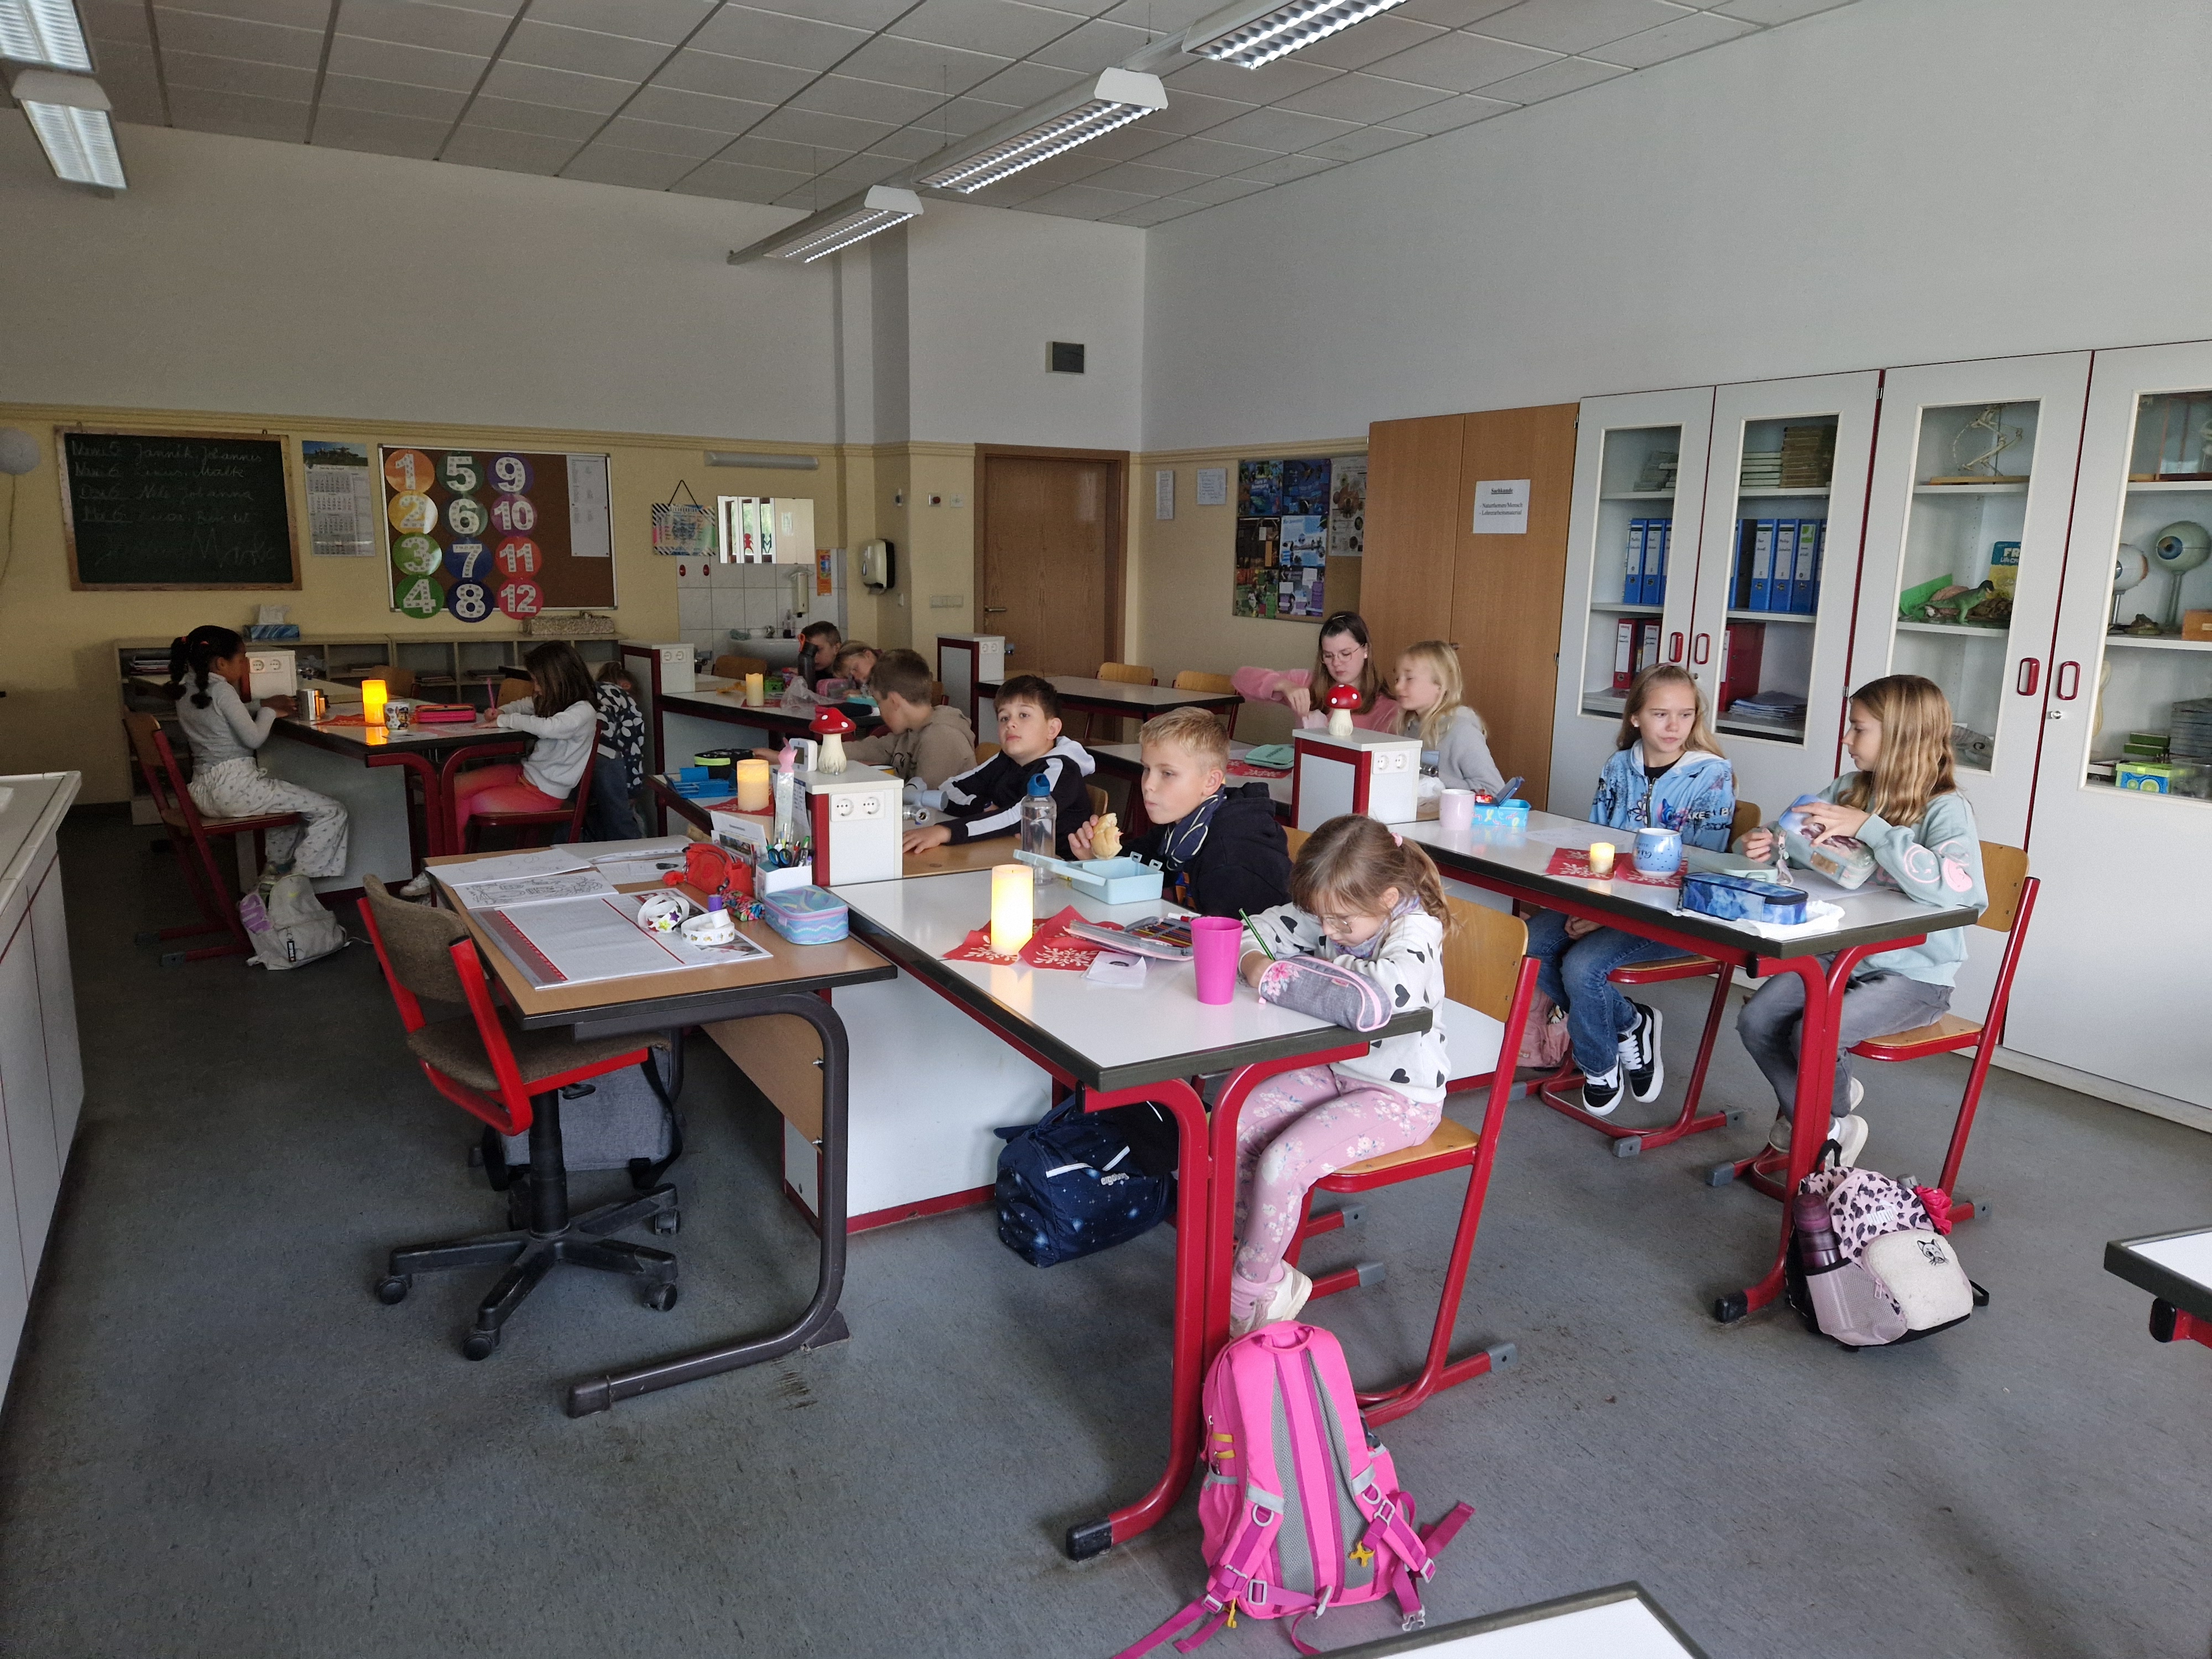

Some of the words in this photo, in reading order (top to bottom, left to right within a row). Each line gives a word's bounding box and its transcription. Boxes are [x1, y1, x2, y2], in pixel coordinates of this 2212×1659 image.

[395, 453, 416, 490] 1
[447, 456, 476, 491] 5
[495, 457, 525, 492] 9
[399, 494, 426, 528] 2
[449, 498, 479, 534] 6
[494, 501, 534, 530] 10
[401, 537, 434, 572] 3
[453, 544, 482, 577] 7
[500, 543, 534, 572] 11
[403, 578, 436, 613] 4
[456, 583, 486, 618] 8
[501, 584, 536, 613] 12
[1687, 811, 1707, 820] AKE
[1100, 1172, 1130, 1186] ergobag
